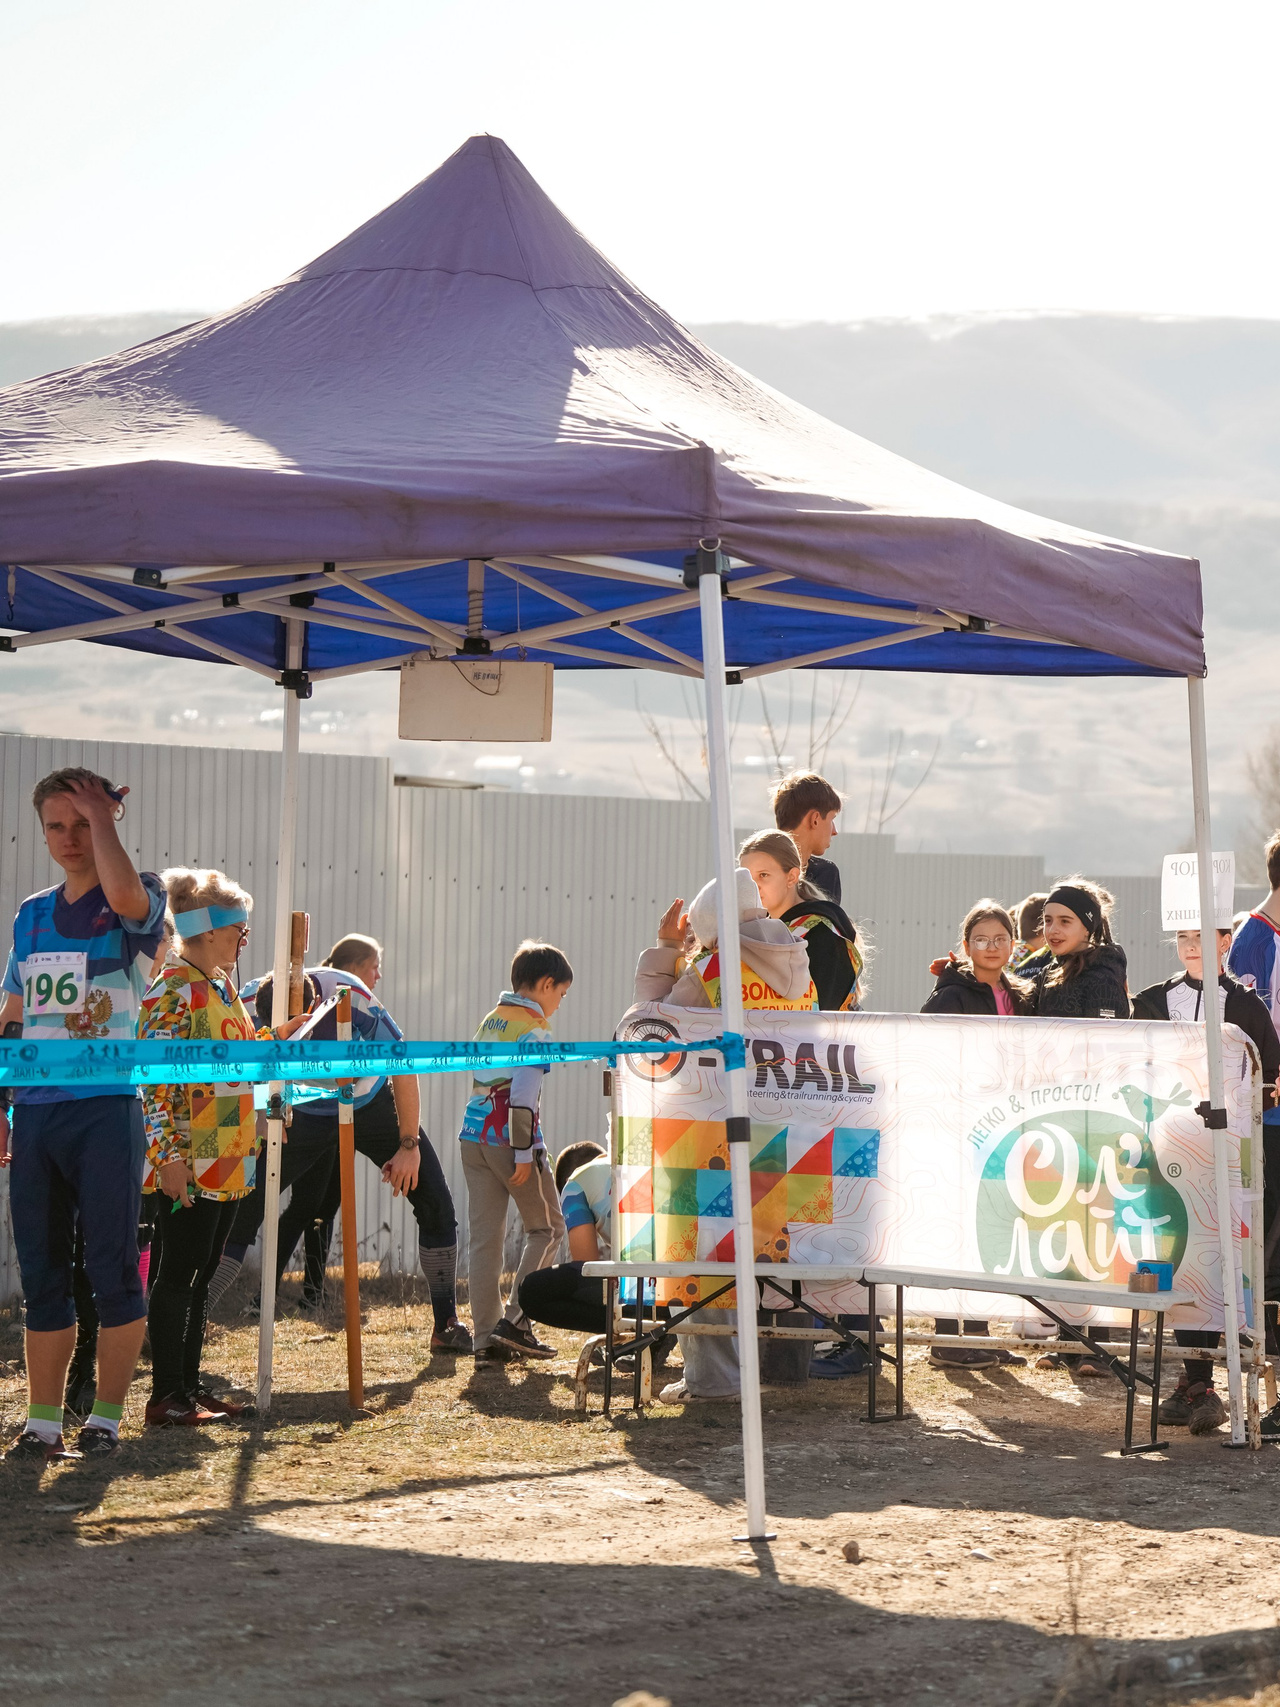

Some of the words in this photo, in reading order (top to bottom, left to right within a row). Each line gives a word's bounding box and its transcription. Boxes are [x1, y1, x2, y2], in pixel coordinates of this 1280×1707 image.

[25, 972, 78, 1008] 196
[482, 1018, 508, 1033] РОМА
[747, 1088, 874, 1104] nteering&trailrunning&cycling
[966, 1106, 1007, 1150] ЛЕГКО
[1008, 1094, 1026, 1114] &
[1031, 1083, 1101, 1107] ПРОСТО!
